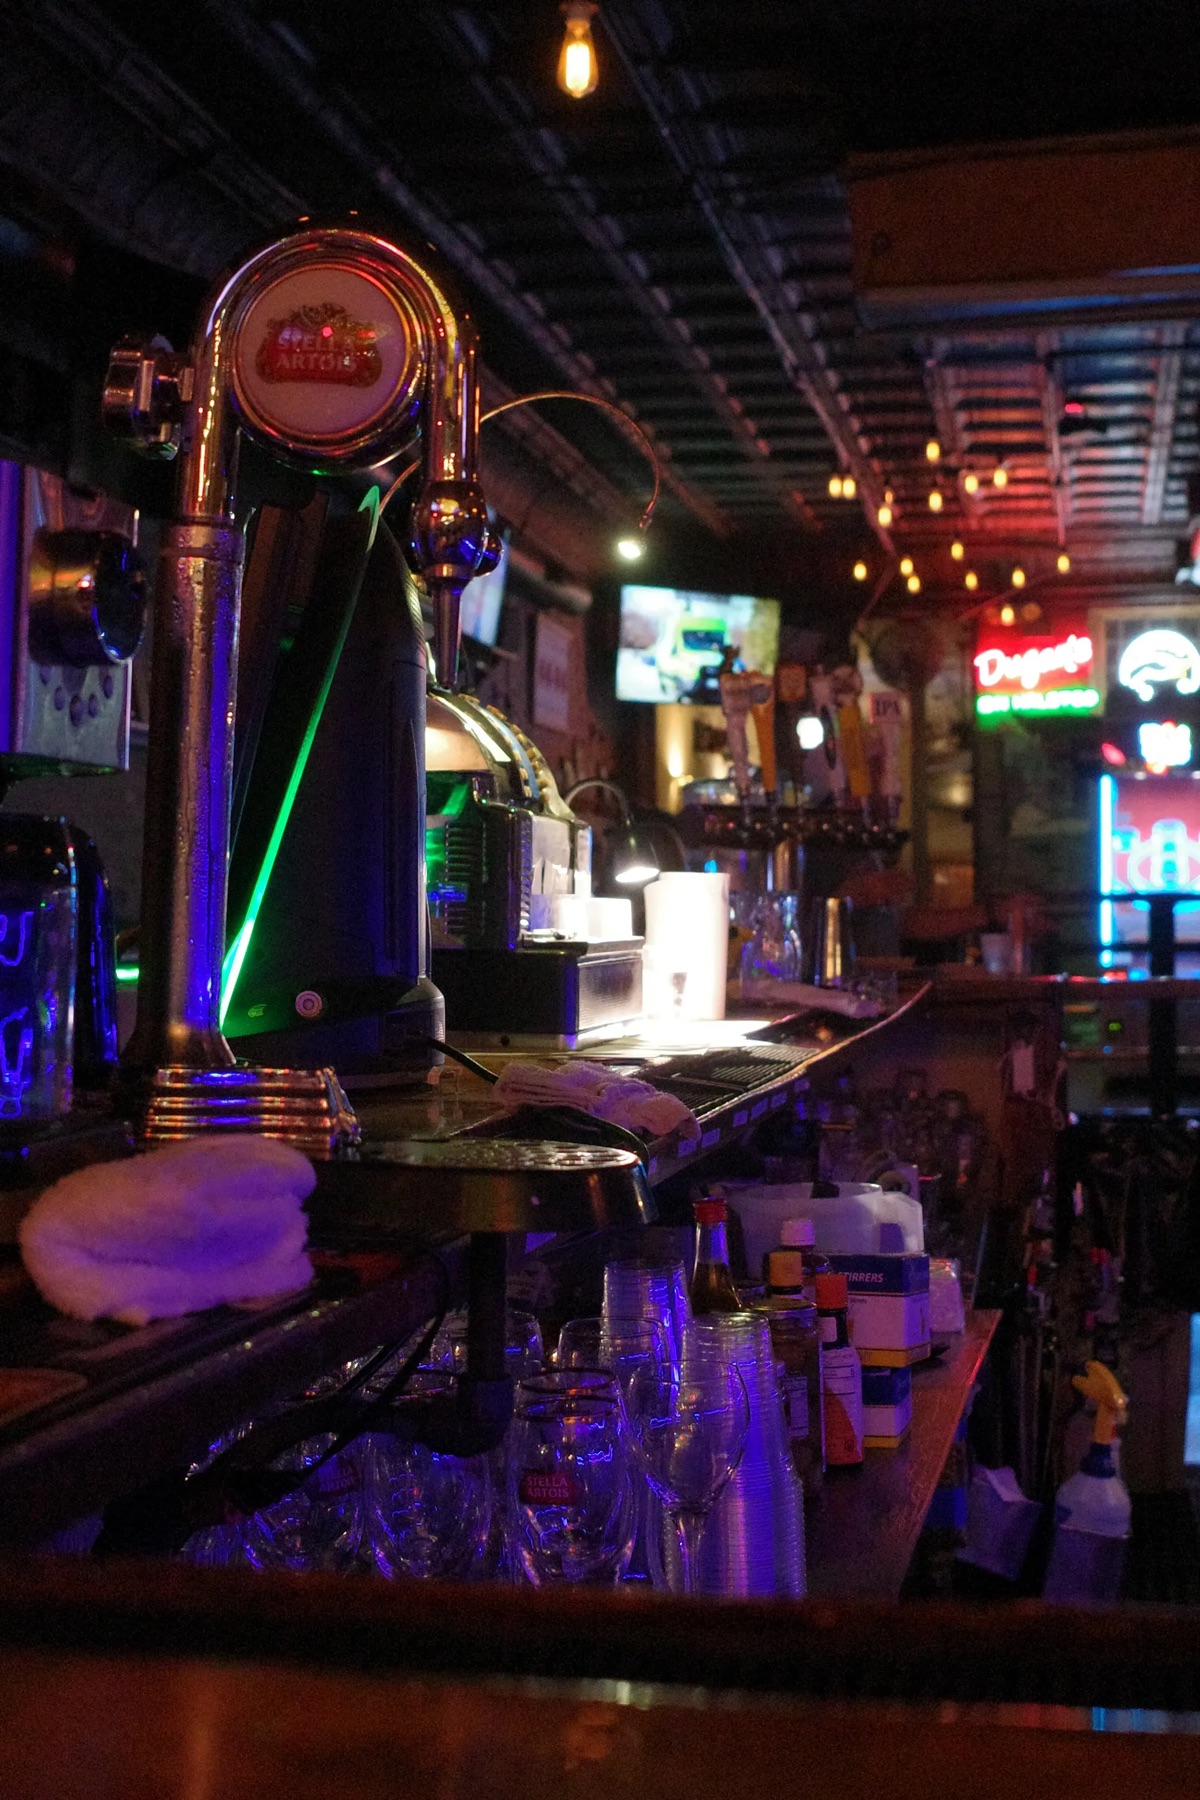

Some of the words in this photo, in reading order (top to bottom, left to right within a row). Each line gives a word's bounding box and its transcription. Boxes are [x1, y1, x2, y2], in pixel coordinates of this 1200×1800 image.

[277, 334, 357, 352] STELLA
[276, 354, 357, 373] ARTOIS
[839, 1271, 884, 1283] TIRRERS
[526, 1475, 568, 1487] STELLA
[527, 1487, 569, 1498] ARTOIS
